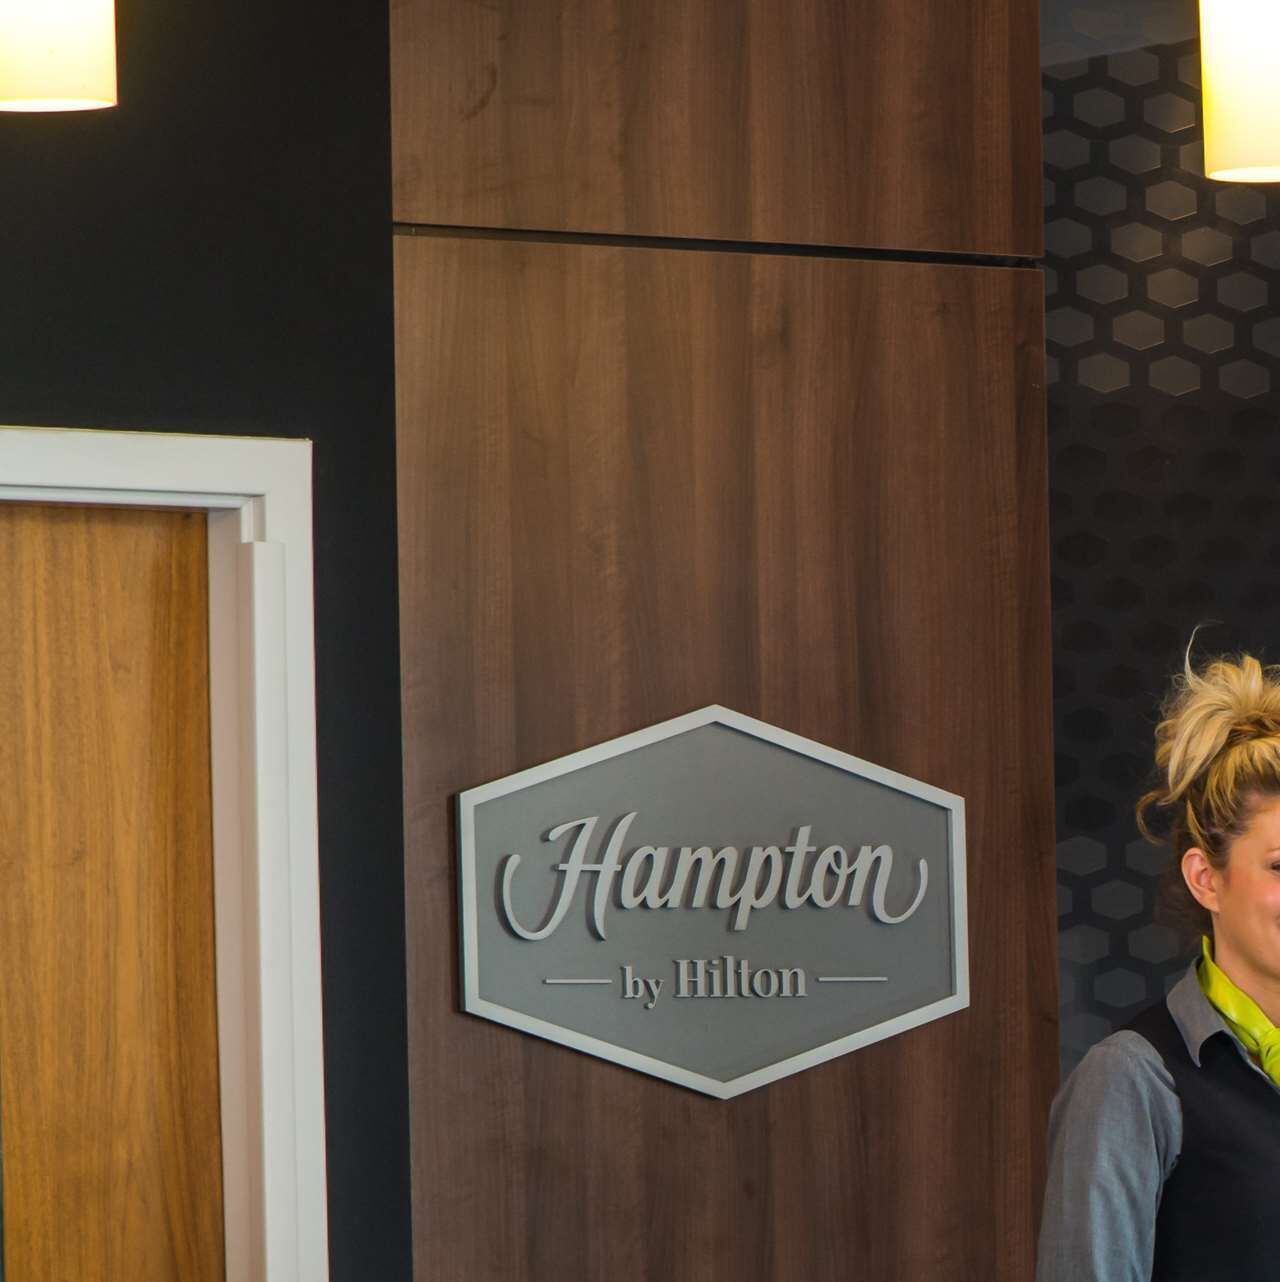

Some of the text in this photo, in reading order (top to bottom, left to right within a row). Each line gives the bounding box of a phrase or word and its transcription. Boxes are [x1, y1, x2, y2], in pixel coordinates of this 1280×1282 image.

[501, 811, 928, 942] Hampton
[620, 954, 808, 1010] by Hilton
